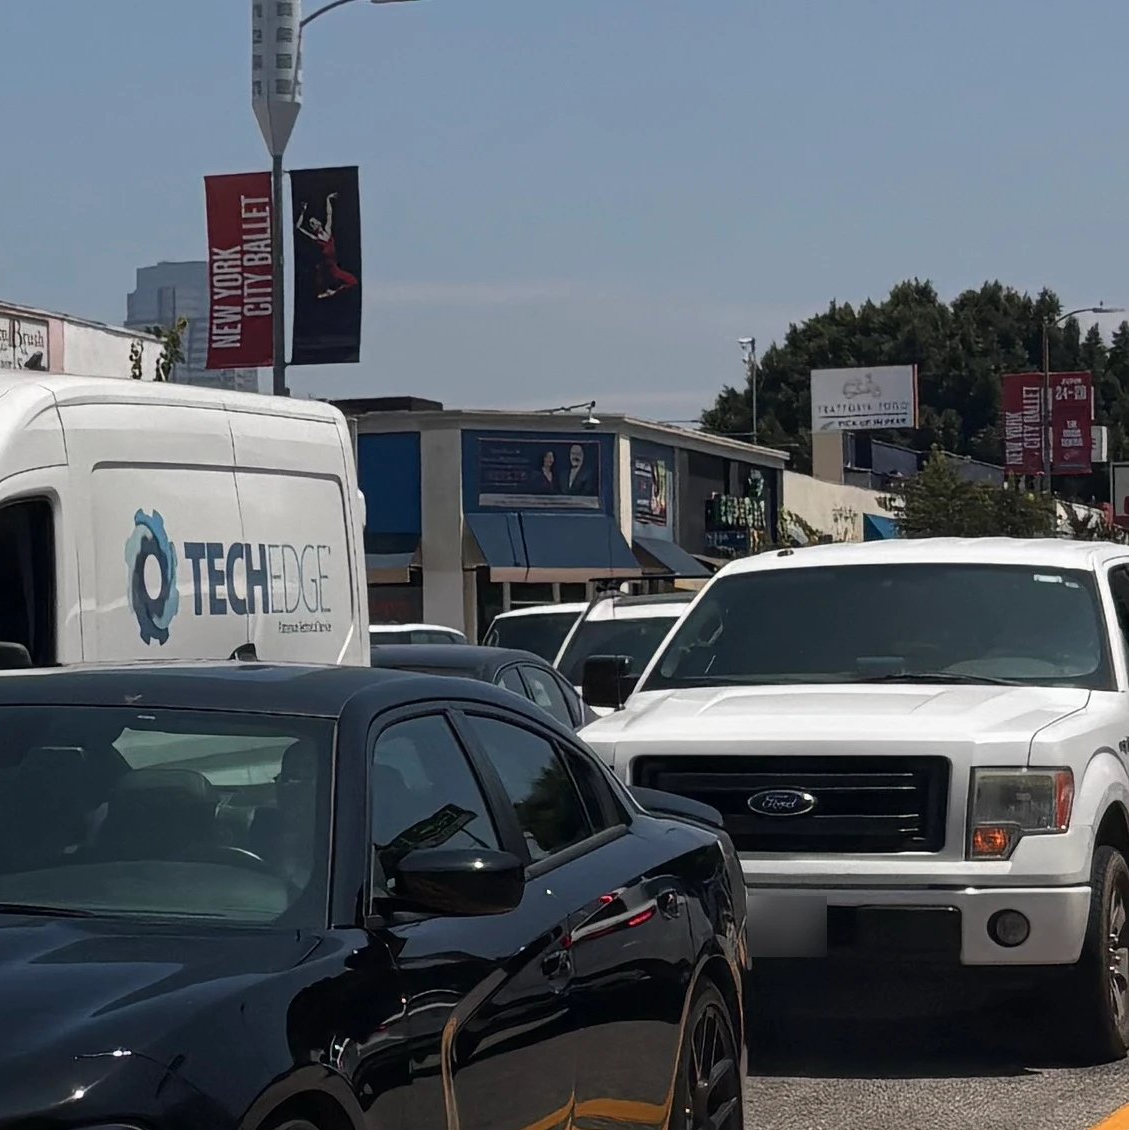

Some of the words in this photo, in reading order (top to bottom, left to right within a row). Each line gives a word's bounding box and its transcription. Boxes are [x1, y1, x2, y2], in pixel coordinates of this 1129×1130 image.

[241, 195, 272, 266] BALLET
[213, 246, 242, 300] YORK
[243, 272, 272, 317] CITY
[212, 306, 242, 349] NEW
[1022, 386, 1040, 423] BALLET
[1005, 411, 1023, 440] YORK
[1023, 424, 1041, 449] CITY
[1005, 440, 1024, 465] NEW
[761, 795, 798, 810] Ford
